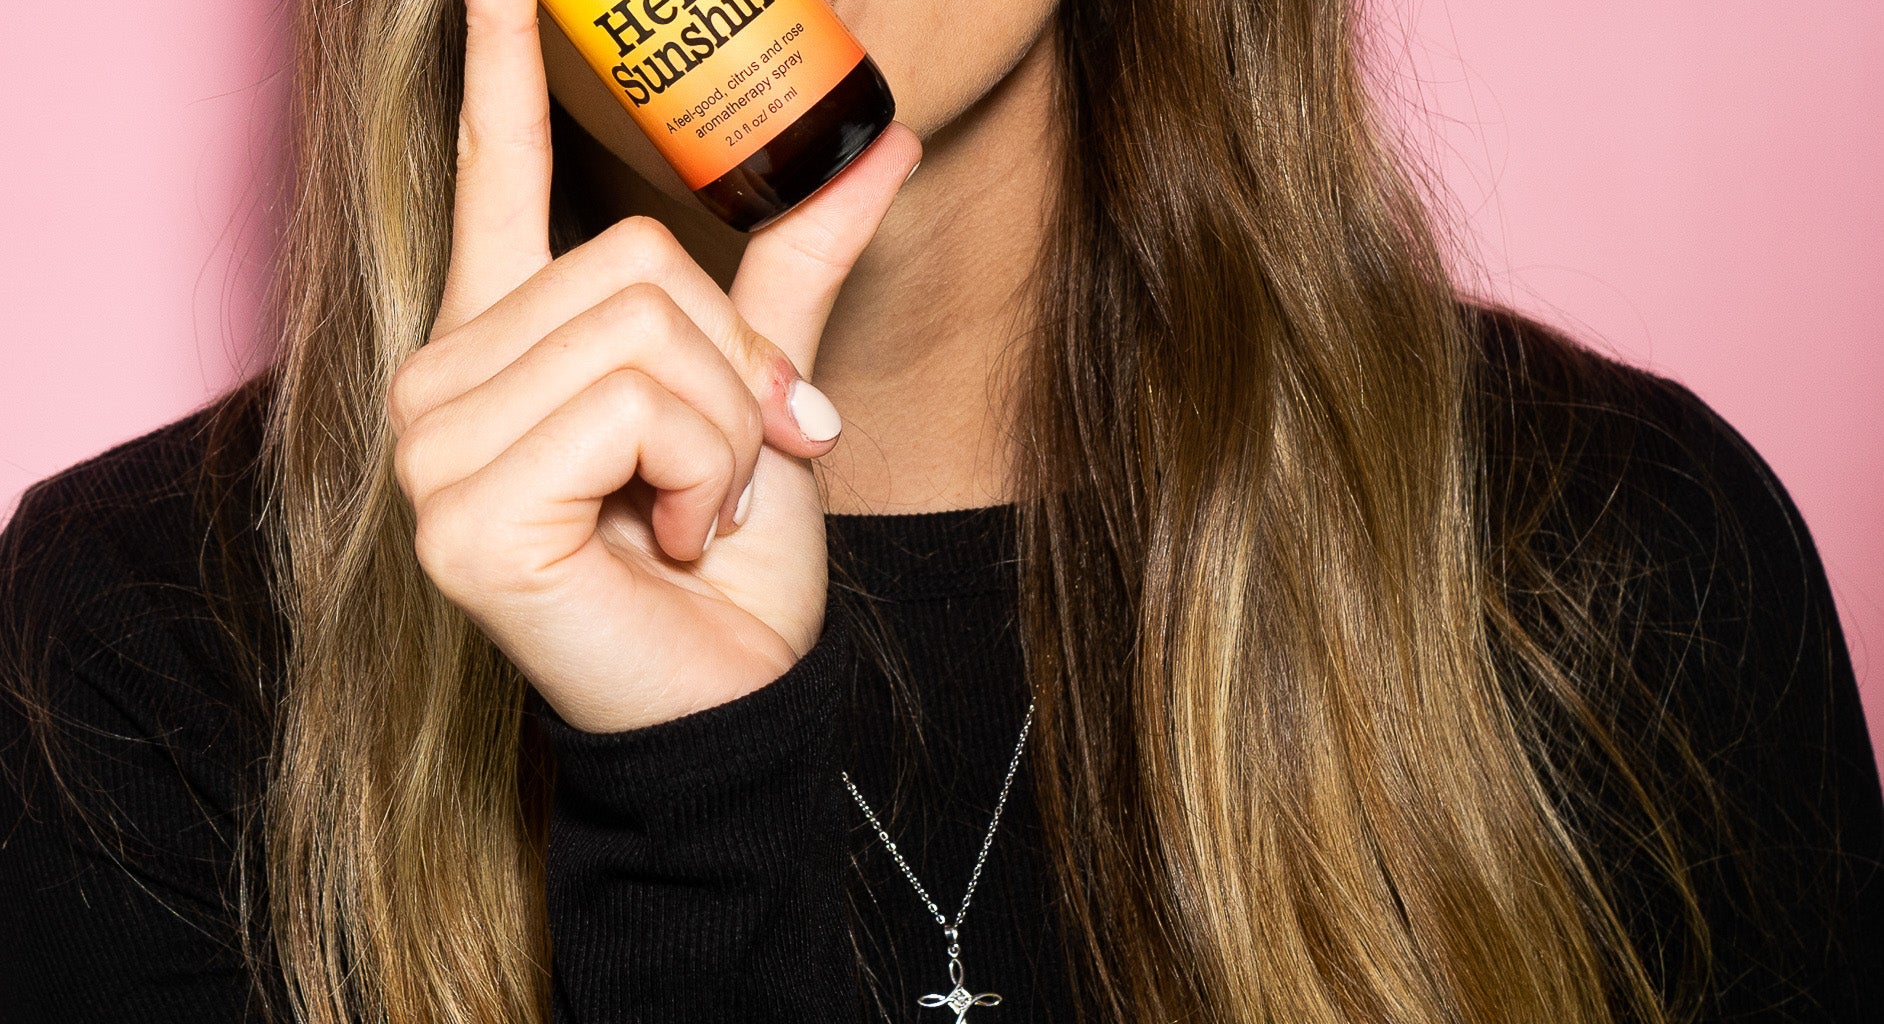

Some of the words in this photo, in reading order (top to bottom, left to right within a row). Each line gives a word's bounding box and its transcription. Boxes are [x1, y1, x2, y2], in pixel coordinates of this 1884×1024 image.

[666, 122, 677, 134] A
[672, 88, 729, 127] feel-good,
[727, 61, 760, 90] citrus
[760, 40, 783, 64] and
[782, 22, 804, 45] rose
[695, 77, 772, 138] aromatherapy
[772, 50, 804, 81] spray
[725, 129, 743, 147] 2.0
[743, 123, 752, 134] fl
[768, 98, 784, 114] 60
[783, 87, 798, 102] ml
